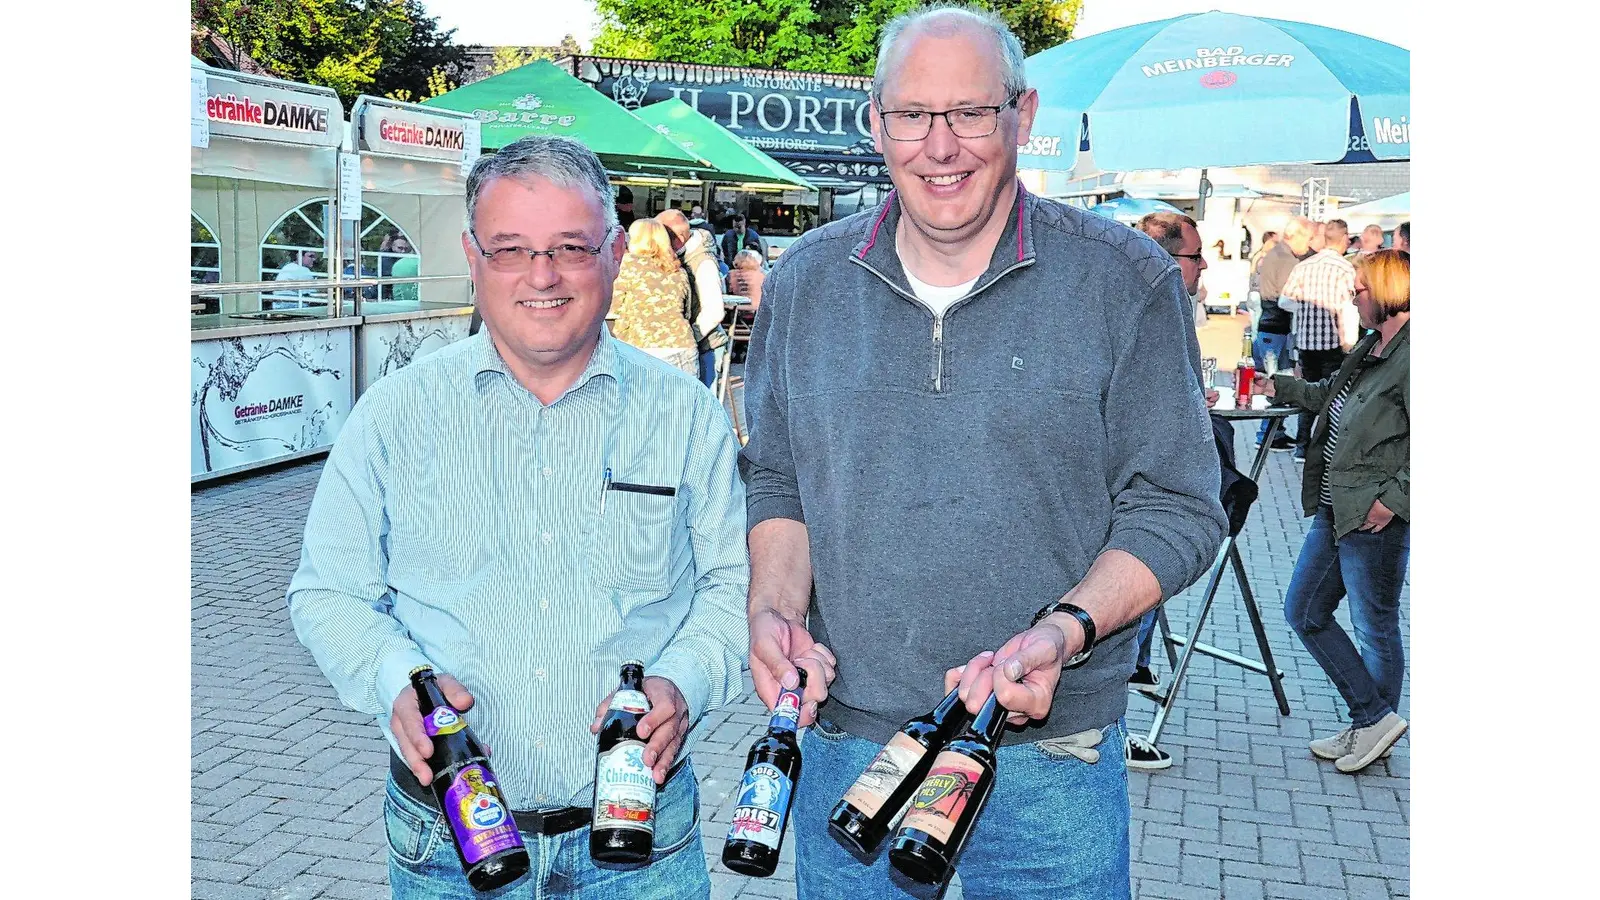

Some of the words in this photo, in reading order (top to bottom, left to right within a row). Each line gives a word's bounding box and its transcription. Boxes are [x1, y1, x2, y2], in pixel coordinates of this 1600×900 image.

[1196, 46, 1244, 58] BAD
[1141, 54, 1295, 78] MEINBERGER
[743, 76, 822, 93] RISTORANTE
[206, 95, 262, 124] etränke
[263, 101, 329, 132] DAMKE
[472, 108, 576, 127] Barre
[380, 118, 424, 145] Getränke
[1373, 115, 1410, 144] Mei
[743, 136, 818, 151] LINDHORST
[234, 402, 268, 419] Getränke
[268, 394, 303, 412] DAMKE
